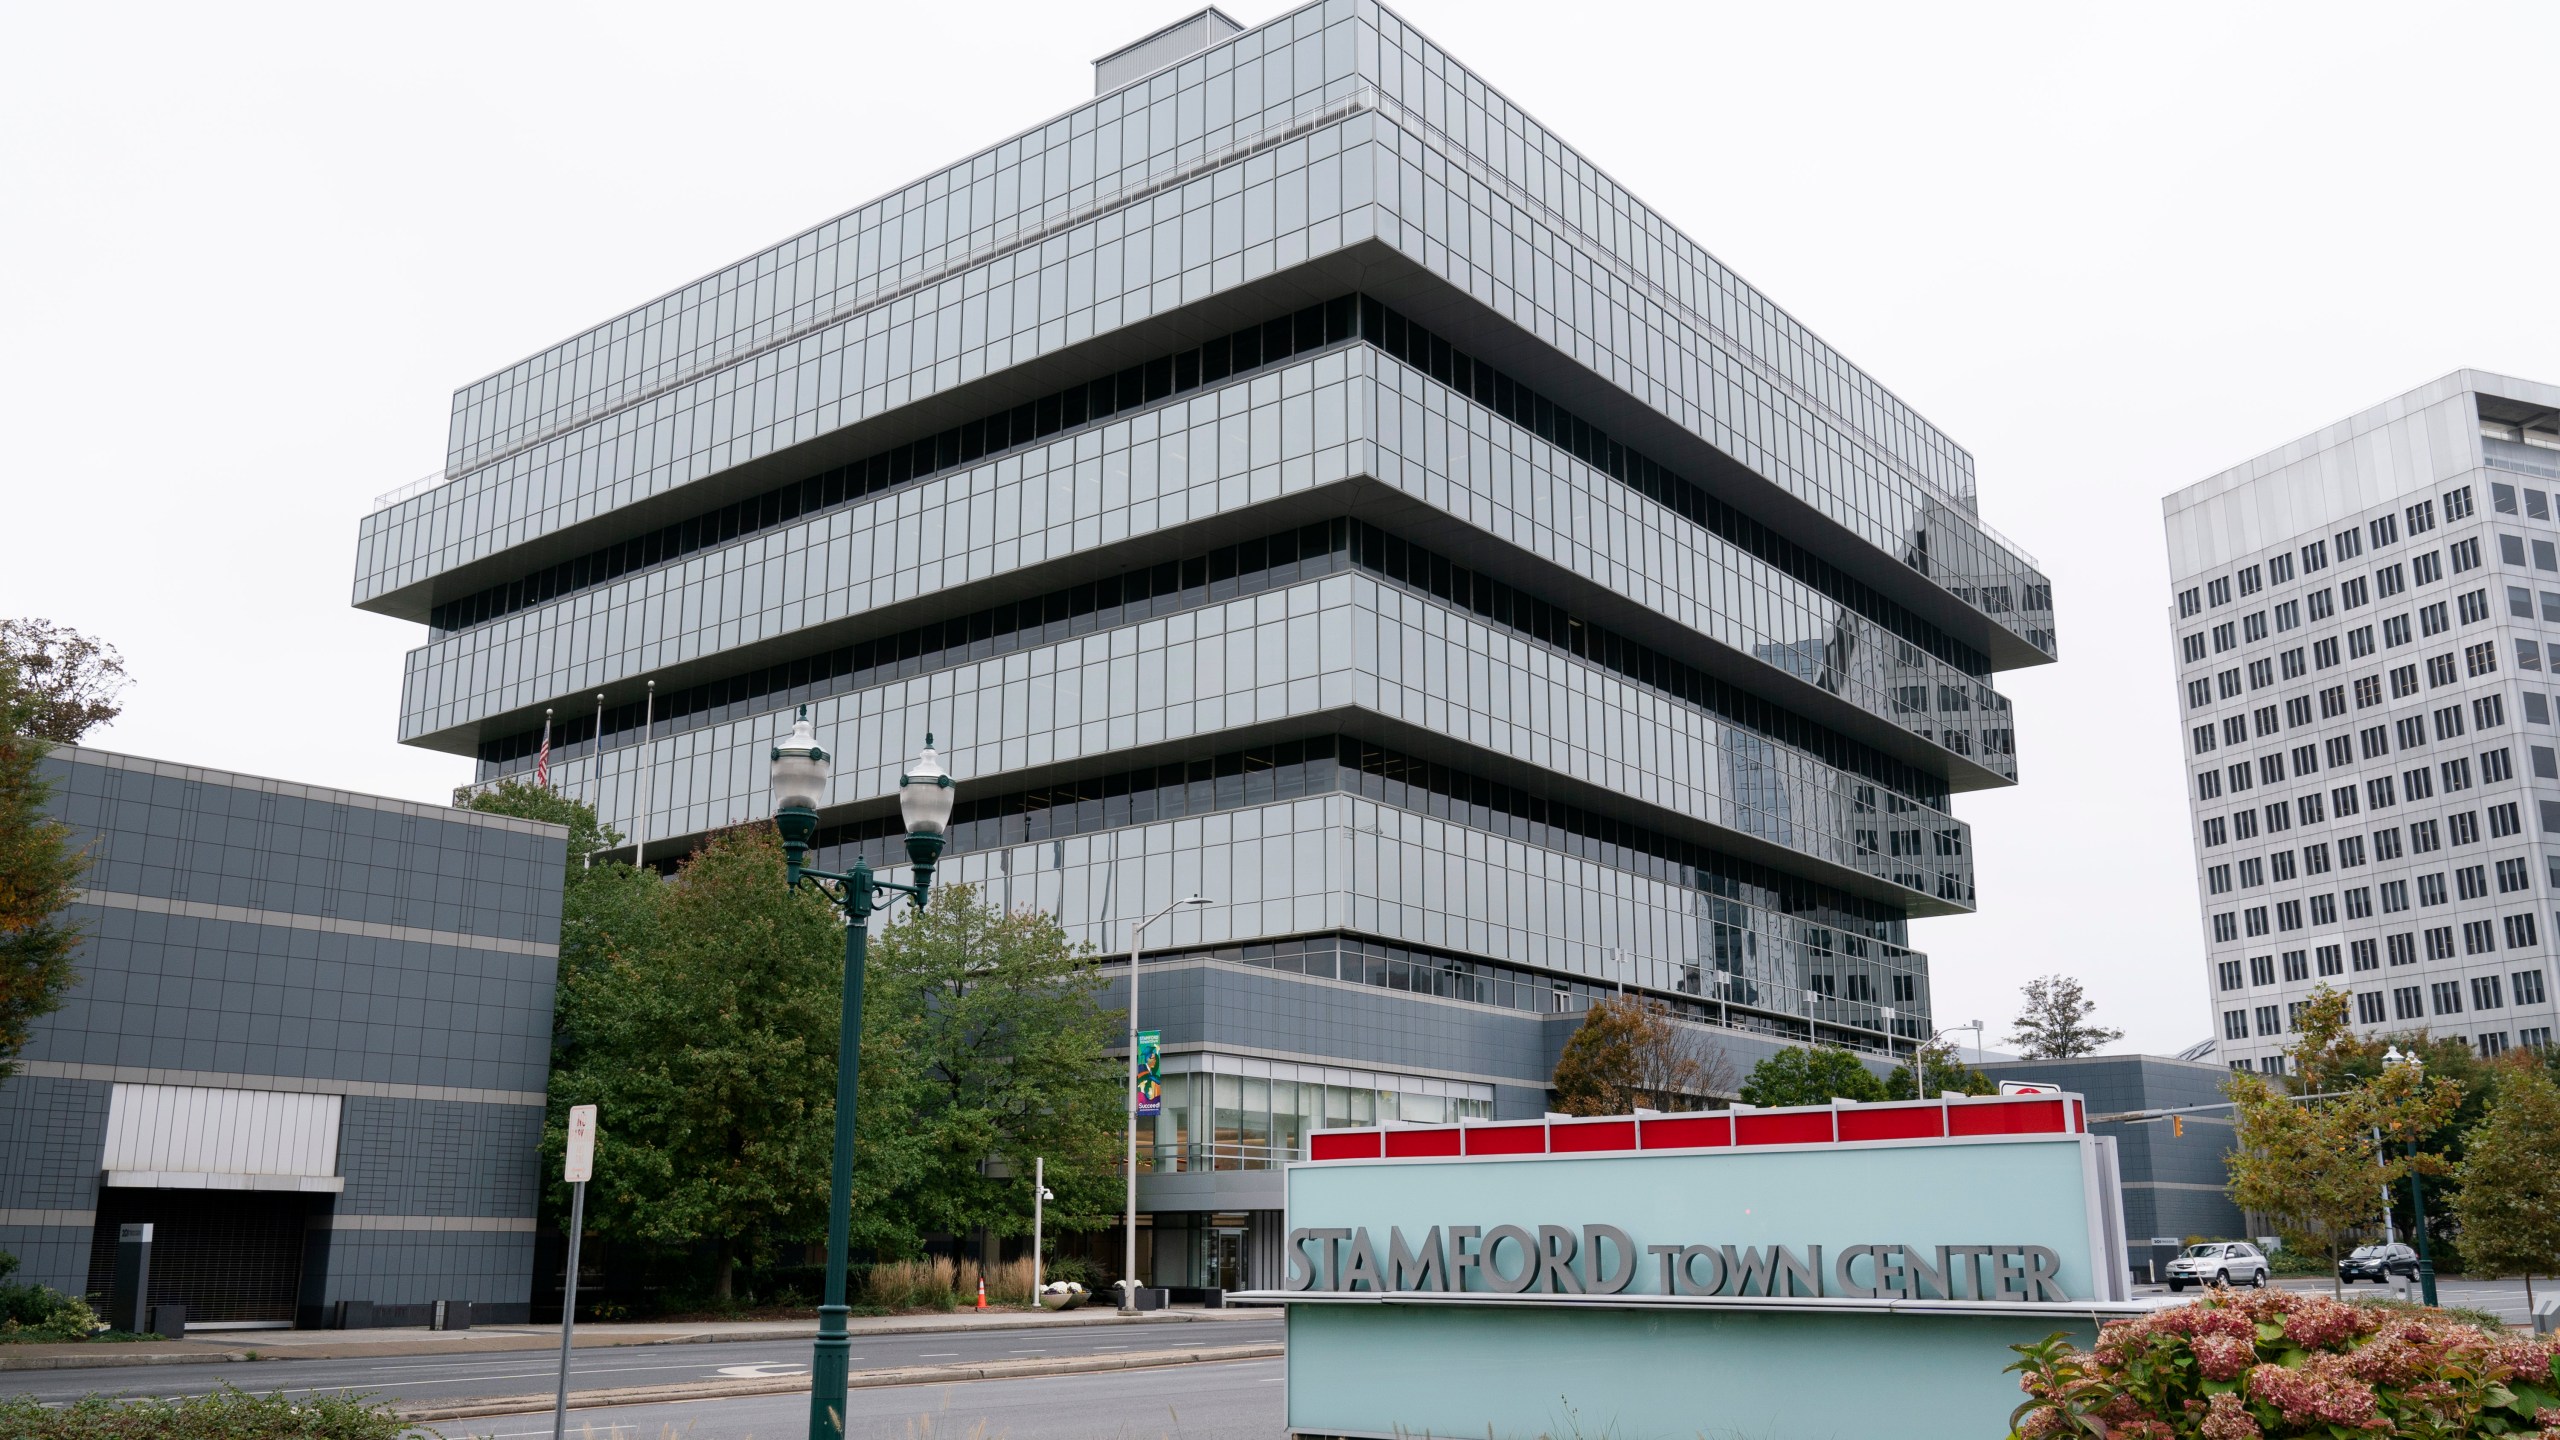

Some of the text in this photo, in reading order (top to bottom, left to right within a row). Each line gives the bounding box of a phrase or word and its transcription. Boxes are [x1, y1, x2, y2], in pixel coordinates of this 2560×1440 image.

[1286, 1223, 2072, 1302] STAMFORD TOWN CENTER
